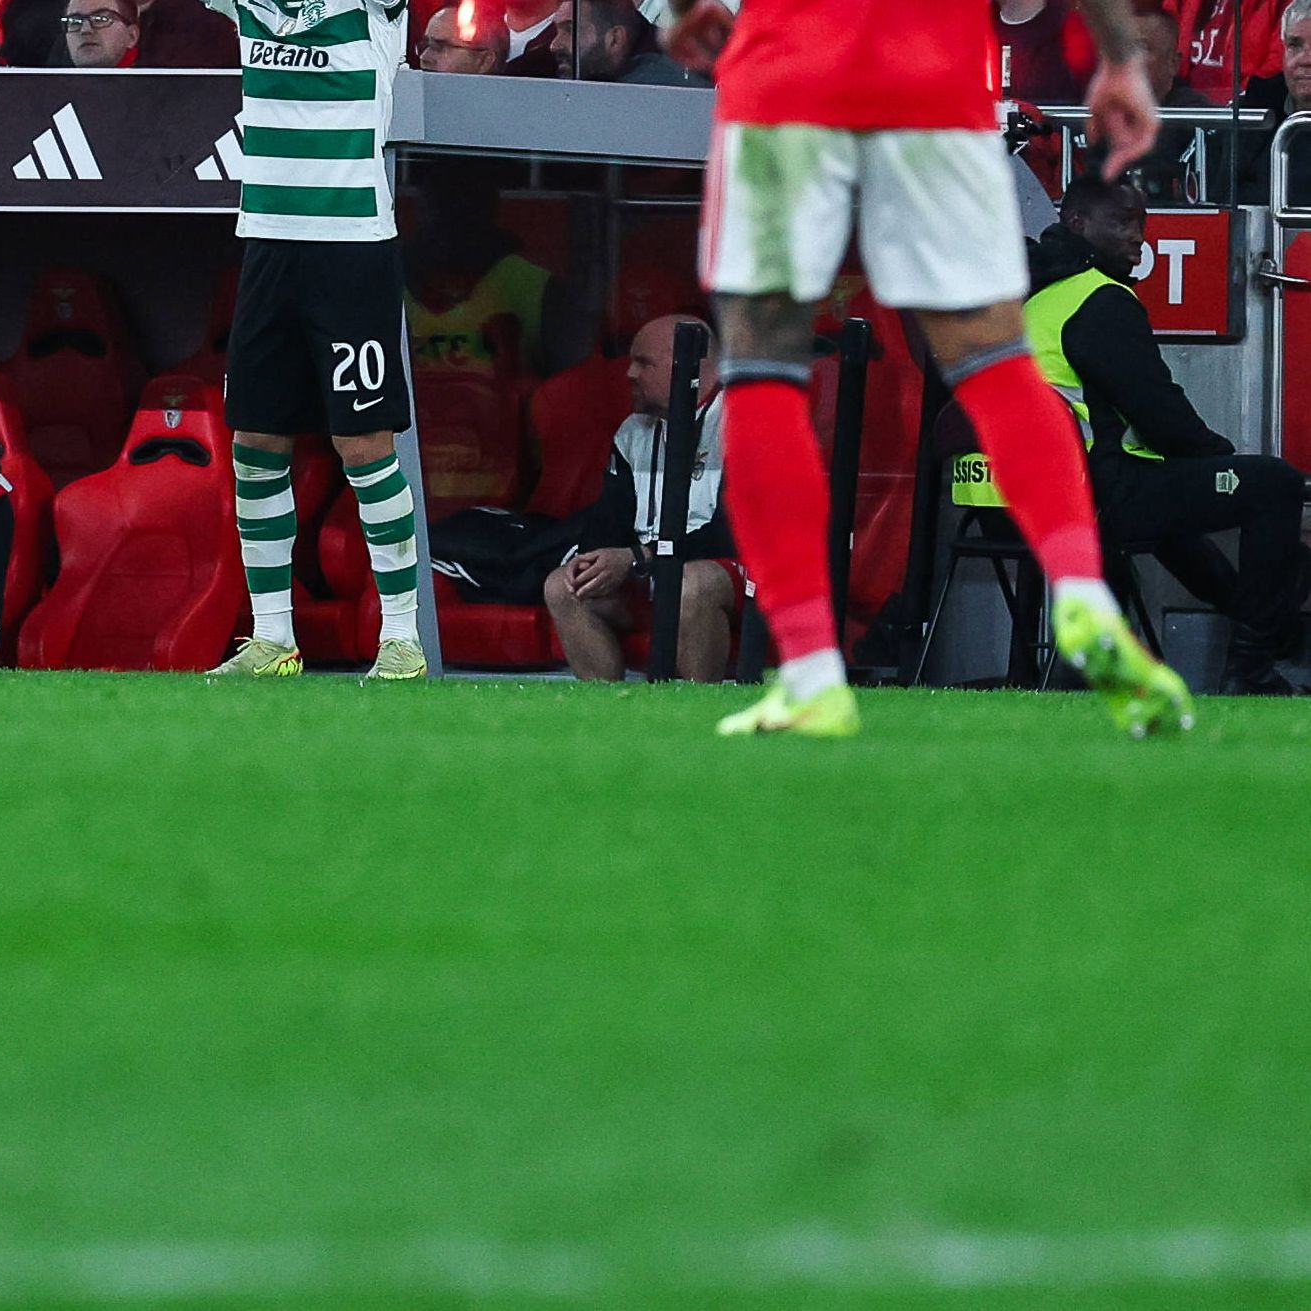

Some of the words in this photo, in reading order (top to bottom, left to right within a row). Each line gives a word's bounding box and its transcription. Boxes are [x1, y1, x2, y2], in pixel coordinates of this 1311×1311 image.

[249, 41, 330, 68] Betano
[331, 339, 386, 392] 20
[952, 460, 993, 483] SSIST
